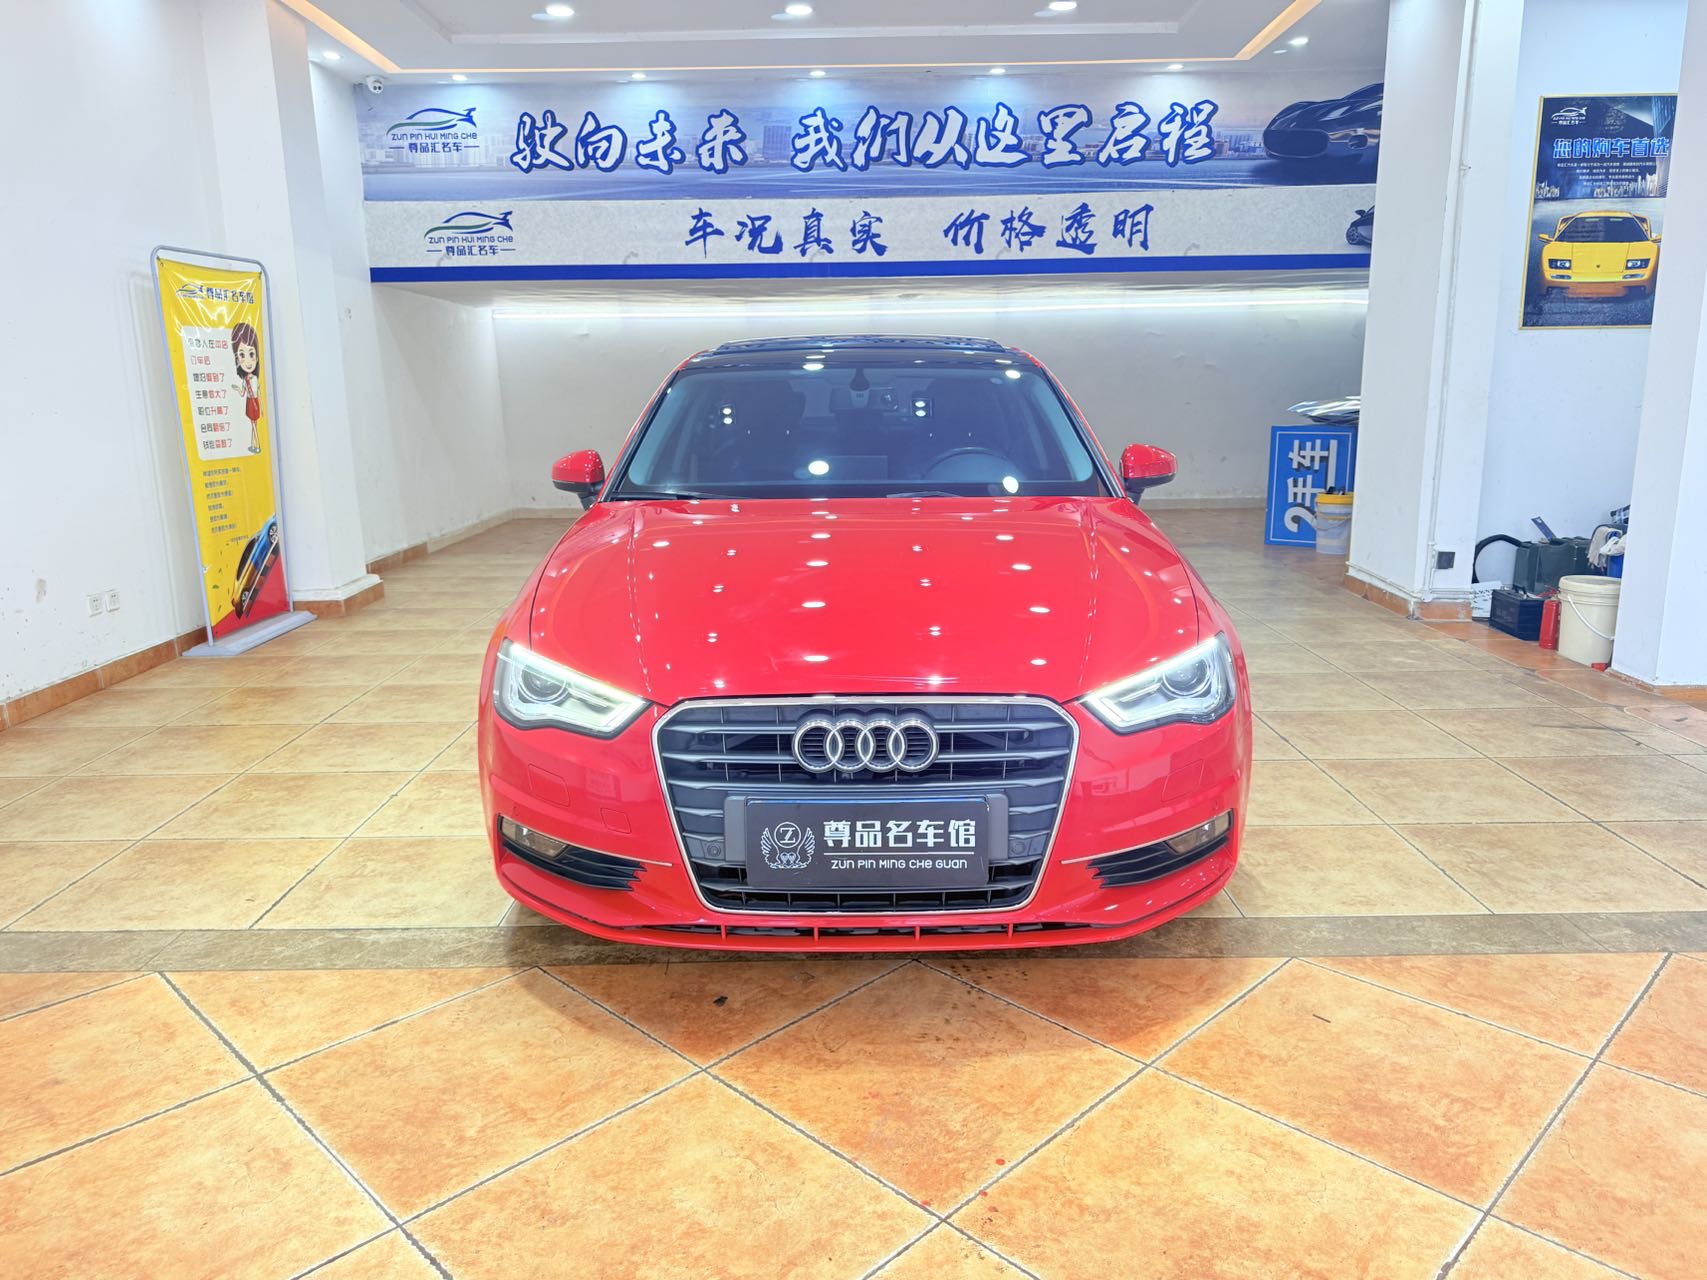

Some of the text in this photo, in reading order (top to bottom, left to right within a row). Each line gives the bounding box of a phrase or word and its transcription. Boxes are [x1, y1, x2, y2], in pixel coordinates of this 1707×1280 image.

[408, 142, 462, 153] 尊品汇名车
[510, 101, 1219, 174] 驶向未来 我们从这里启程
[1553, 137, 1670, 158] 您的购车首选
[685, 203, 1154, 258] 车况真实 价格透明
[445, 245, 498, 256] 尊品汇名车
[1284, 439, 1327, 533] 2手车
[823, 818, 976, 848] 尊品名车馆
